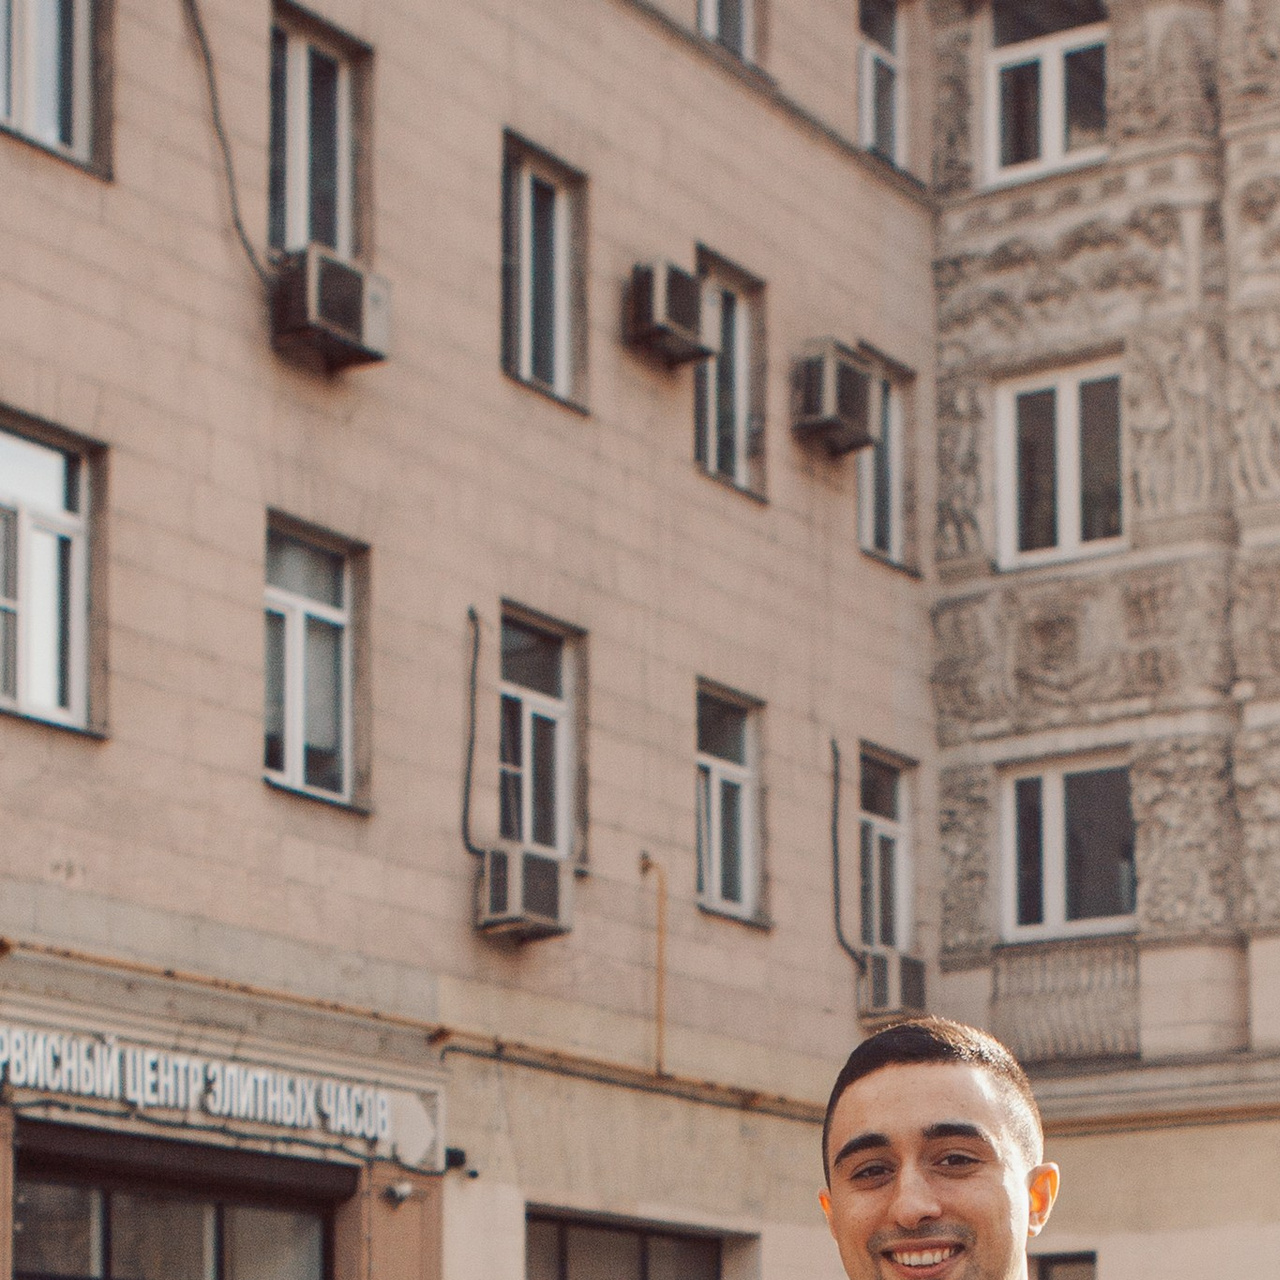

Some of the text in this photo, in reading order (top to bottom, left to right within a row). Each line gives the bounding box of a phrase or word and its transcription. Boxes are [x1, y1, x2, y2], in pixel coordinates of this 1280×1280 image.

[126, 1049, 203, 1111] ЦЕНТР
[206, 1061, 318, 1128] ЭЛИТНЫХ
[321, 1081, 391, 1141] ЧАСОВ
